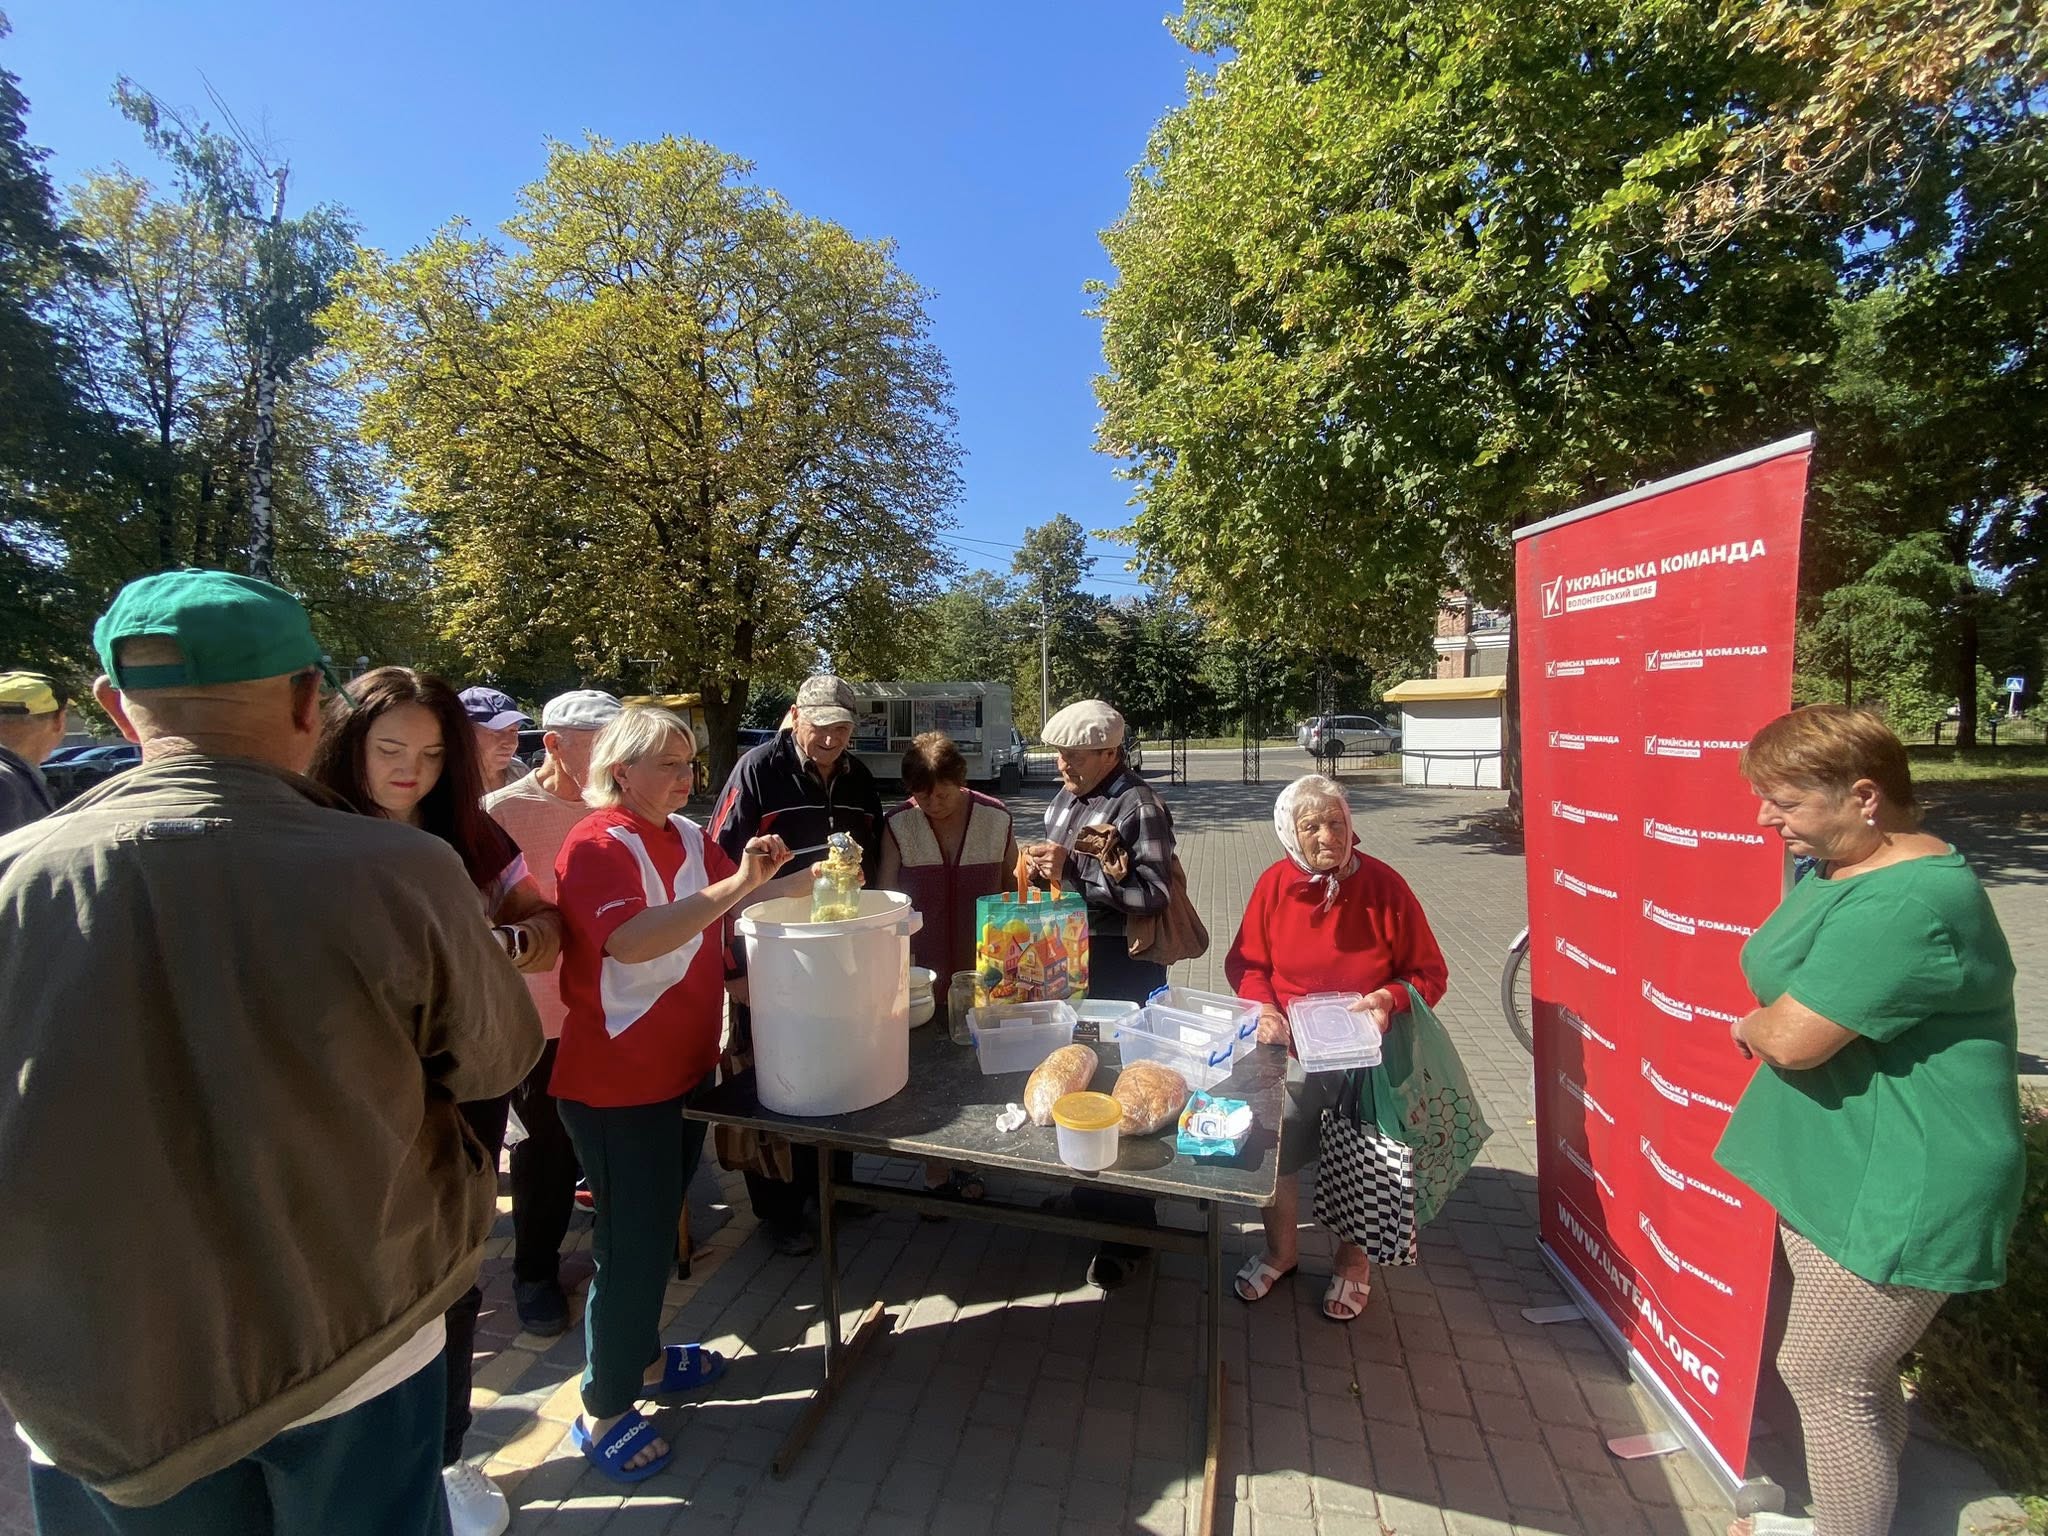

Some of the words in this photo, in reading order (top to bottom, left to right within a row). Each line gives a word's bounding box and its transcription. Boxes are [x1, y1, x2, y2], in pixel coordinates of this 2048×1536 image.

[1566, 561, 1657, 593] УКРАЇНСЬКА
[1660, 539, 1766, 574] КОМАНДА
[1568, 588, 1631, 608] ВОЛОНТЕРСЬКИЙ
[1632, 585, 1653, 598] ШТАБ
[1660, 649, 1703, 660] УКРАЇНСЬКА
[1705, 645, 1768, 657] КОМАНДА
[1703, 740, 1749, 749] КОМАН
[1700, 831, 1764, 845] КОМАНДА
[1691, 1091, 1736, 1114] КОМАН
[1686, 1175, 1742, 1209] КОМАНДА
[1681, 1259, 1733, 1297] КОМАНДА
[1557, 1201, 1721, 1396] WWW.UATEAM.ORG
[604, 1420, 650, 1459] Reebo
